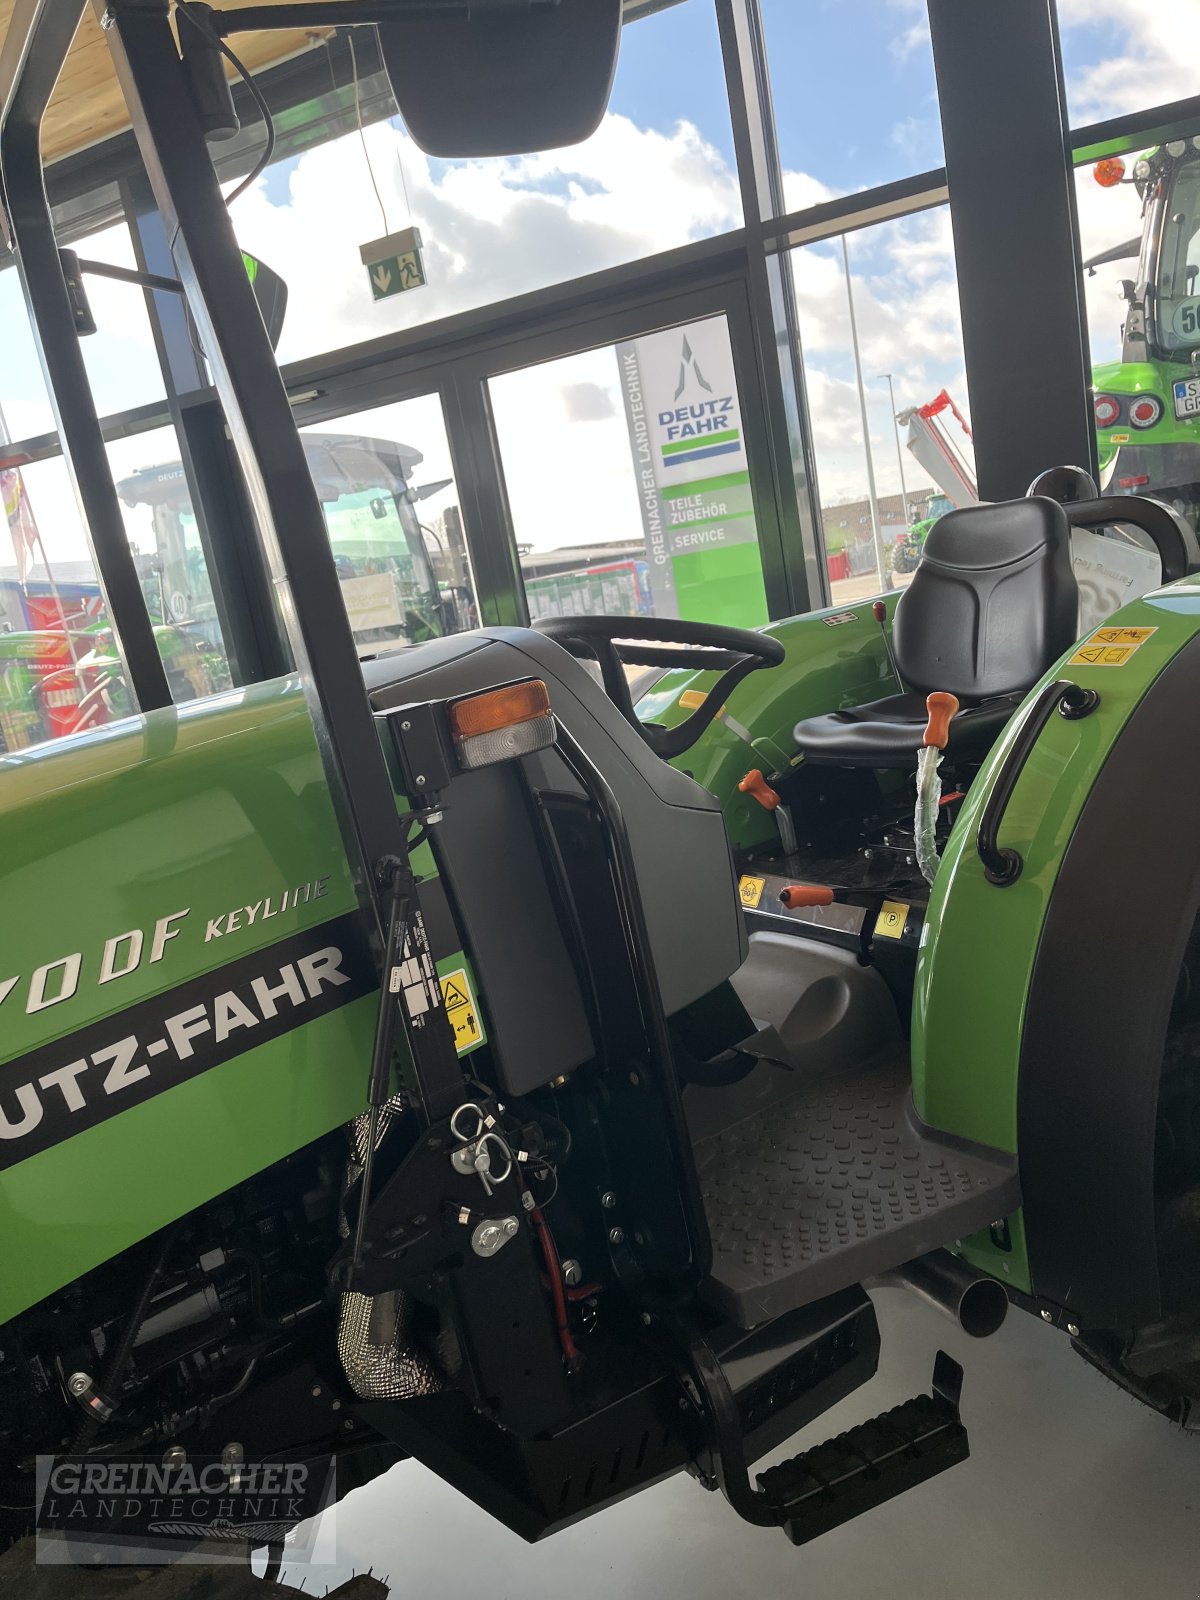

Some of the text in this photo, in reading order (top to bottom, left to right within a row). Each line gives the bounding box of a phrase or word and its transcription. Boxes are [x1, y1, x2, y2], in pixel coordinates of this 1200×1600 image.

[658, 396, 734, 426] DEUTZ
[667, 415, 729, 441] FAHR
[623, 351, 667, 565] GREINACHER LANDTECHNIK
[669, 494, 703, 512] TEILE
[671, 502, 728, 525] ZUBEHÖR
[675, 528, 725, 548] SERVICE
[173, 596, 185, 614] 40
[98, 908, 191, 985] DF
[204, 874, 332, 943] KEYLINE
